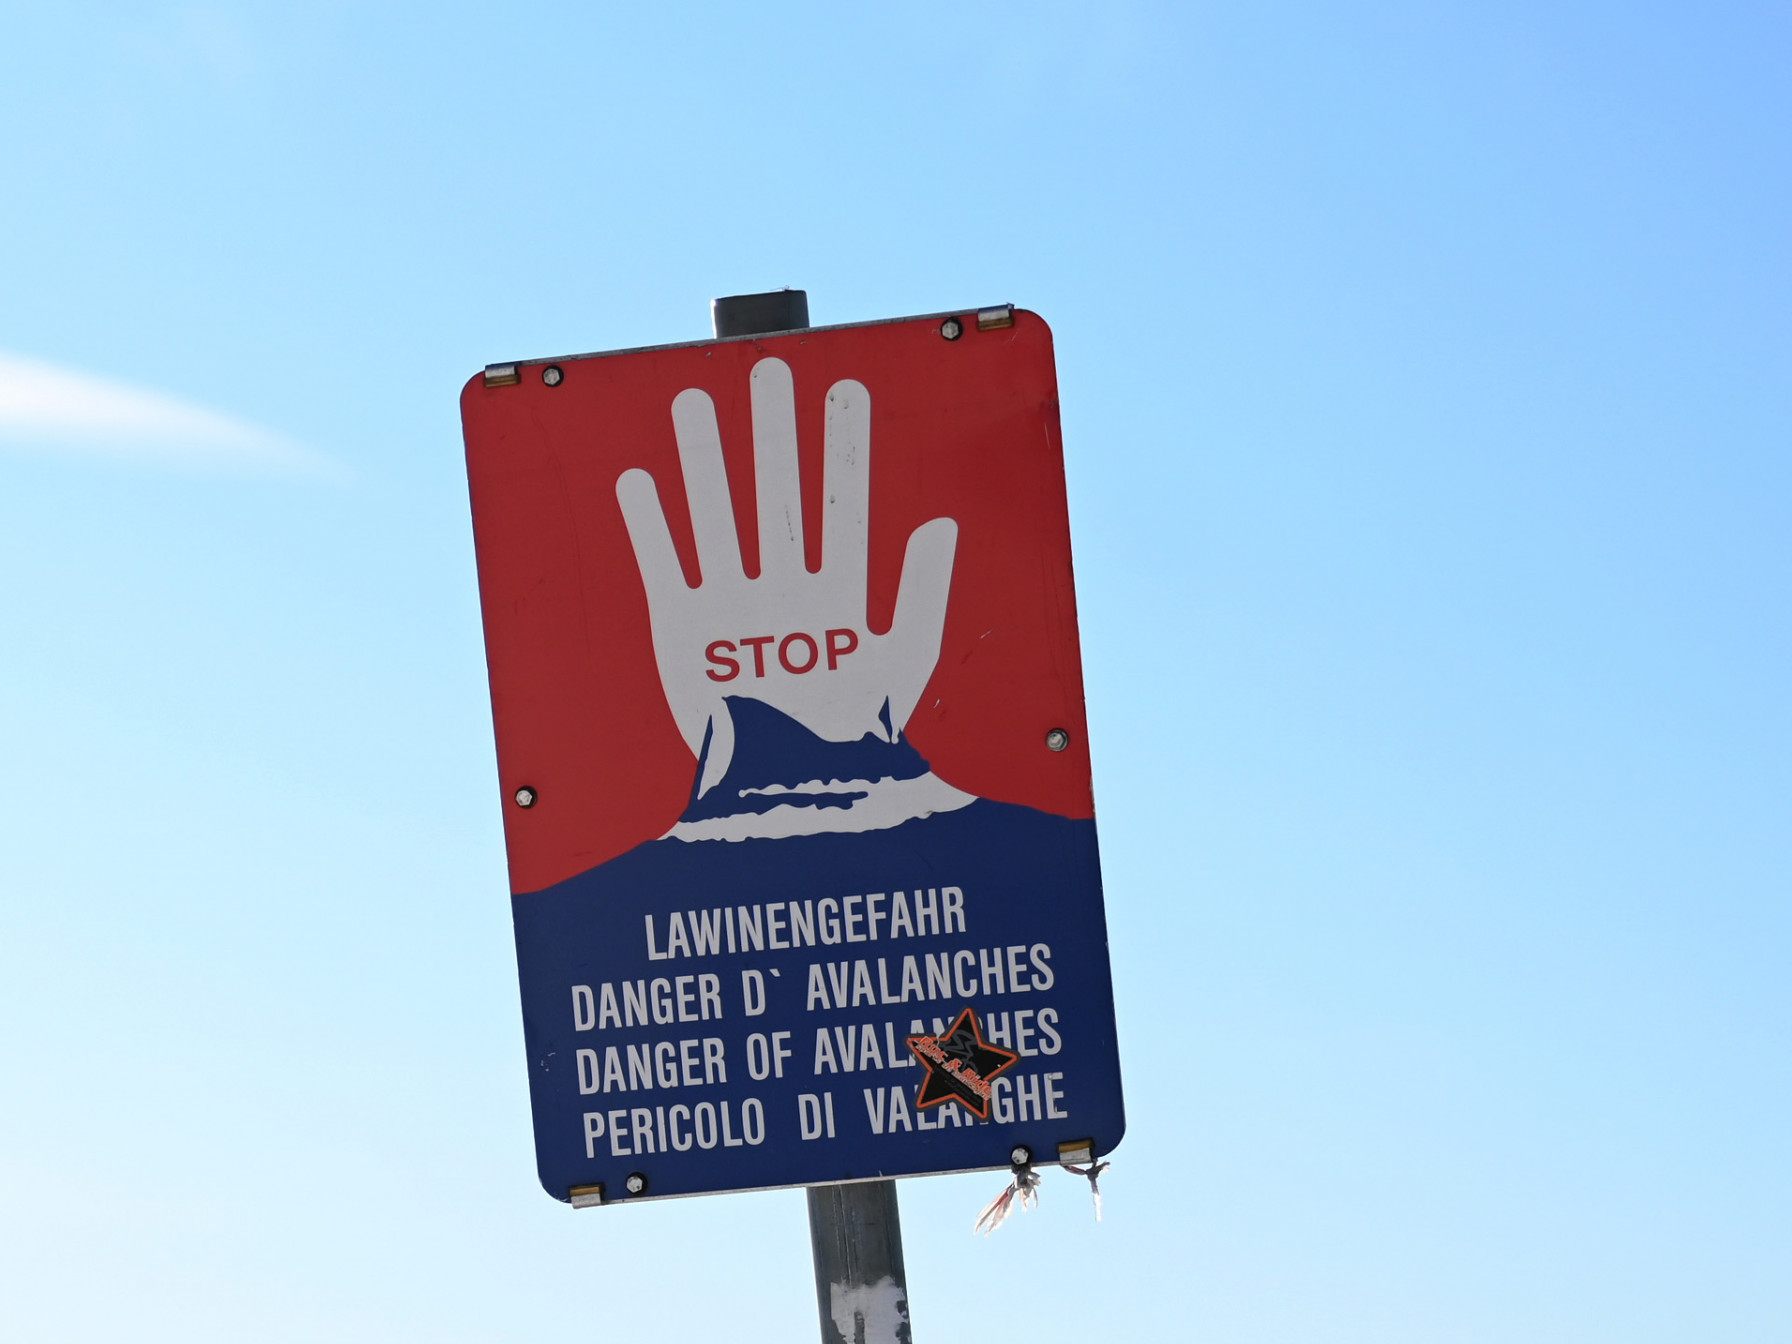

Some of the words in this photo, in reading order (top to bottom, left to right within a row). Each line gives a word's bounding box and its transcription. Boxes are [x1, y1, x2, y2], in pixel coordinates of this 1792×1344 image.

[705, 628, 858, 682] STOP
[644, 886, 967, 961] LAWINENGEFAHR
[571, 974, 723, 1032] DANGER
[806, 943, 1055, 1011] AVALANCHES
[575, 1037, 727, 1095] DANGER
[746, 1030, 792, 1081] OF
[583, 1097, 765, 1159] PERICOLO
[797, 1091, 836, 1141] DI
